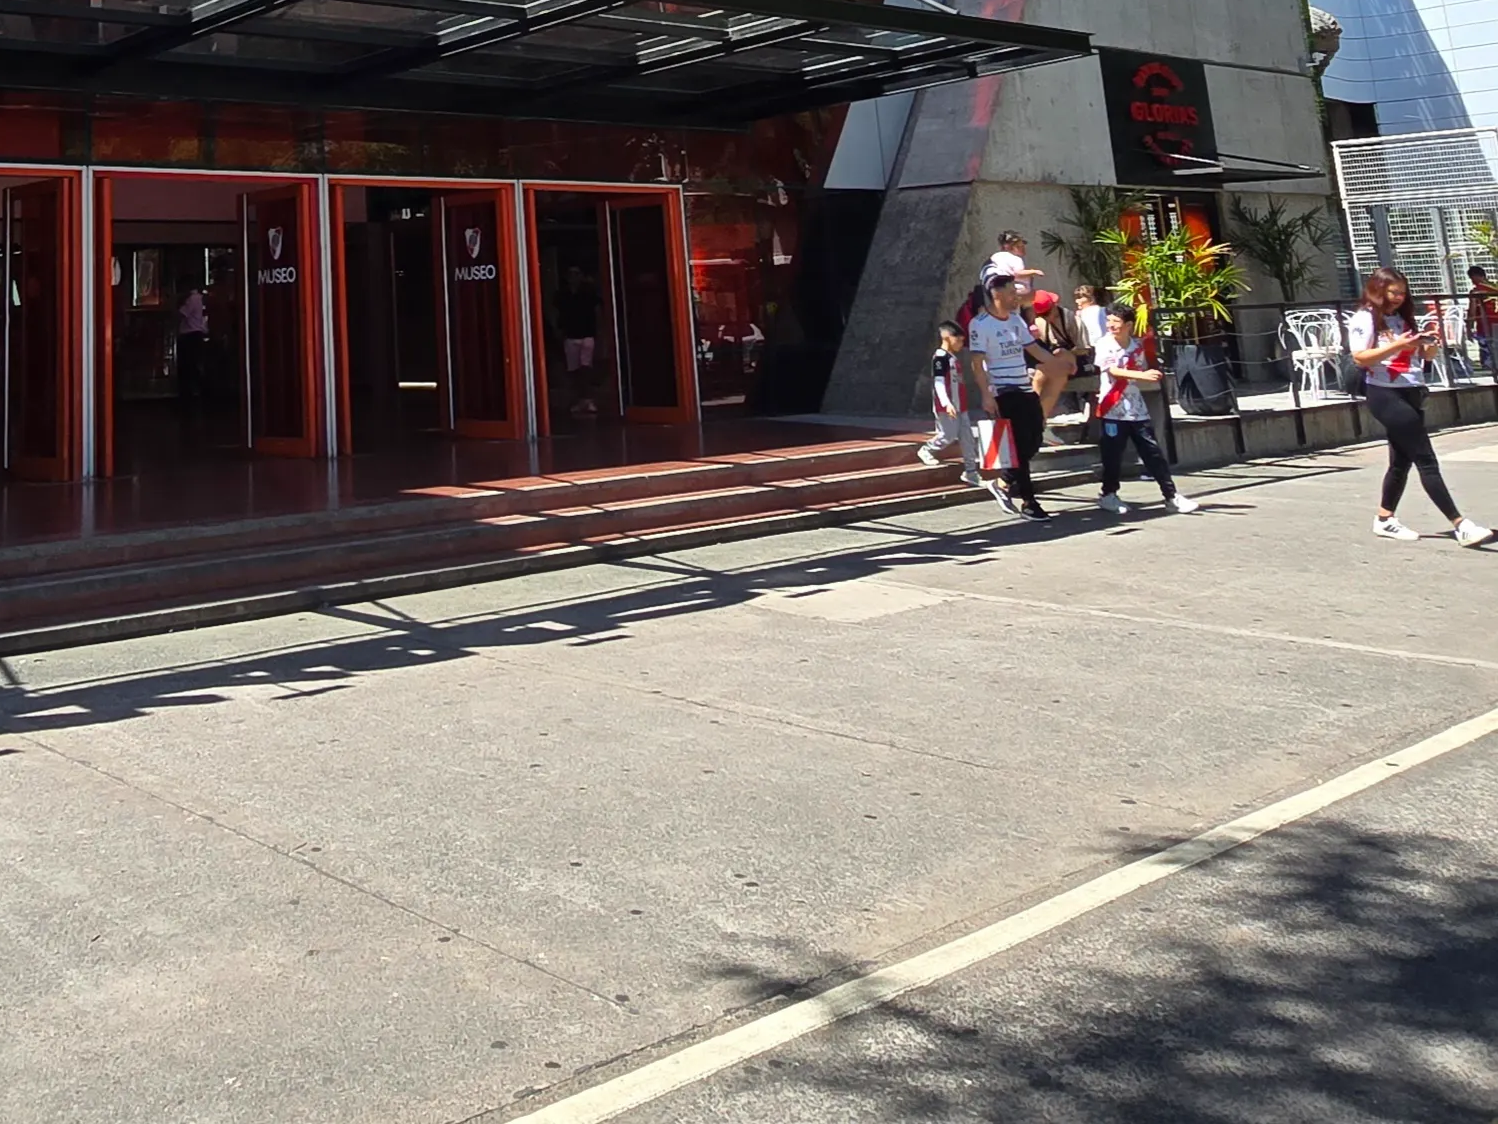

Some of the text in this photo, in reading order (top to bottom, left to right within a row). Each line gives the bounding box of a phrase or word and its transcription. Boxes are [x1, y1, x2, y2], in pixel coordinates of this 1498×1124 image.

[1129, 101, 1199, 125] GLORIAS
[257, 266, 297, 286] MUSEO
[454, 264, 497, 282] MUSEO
